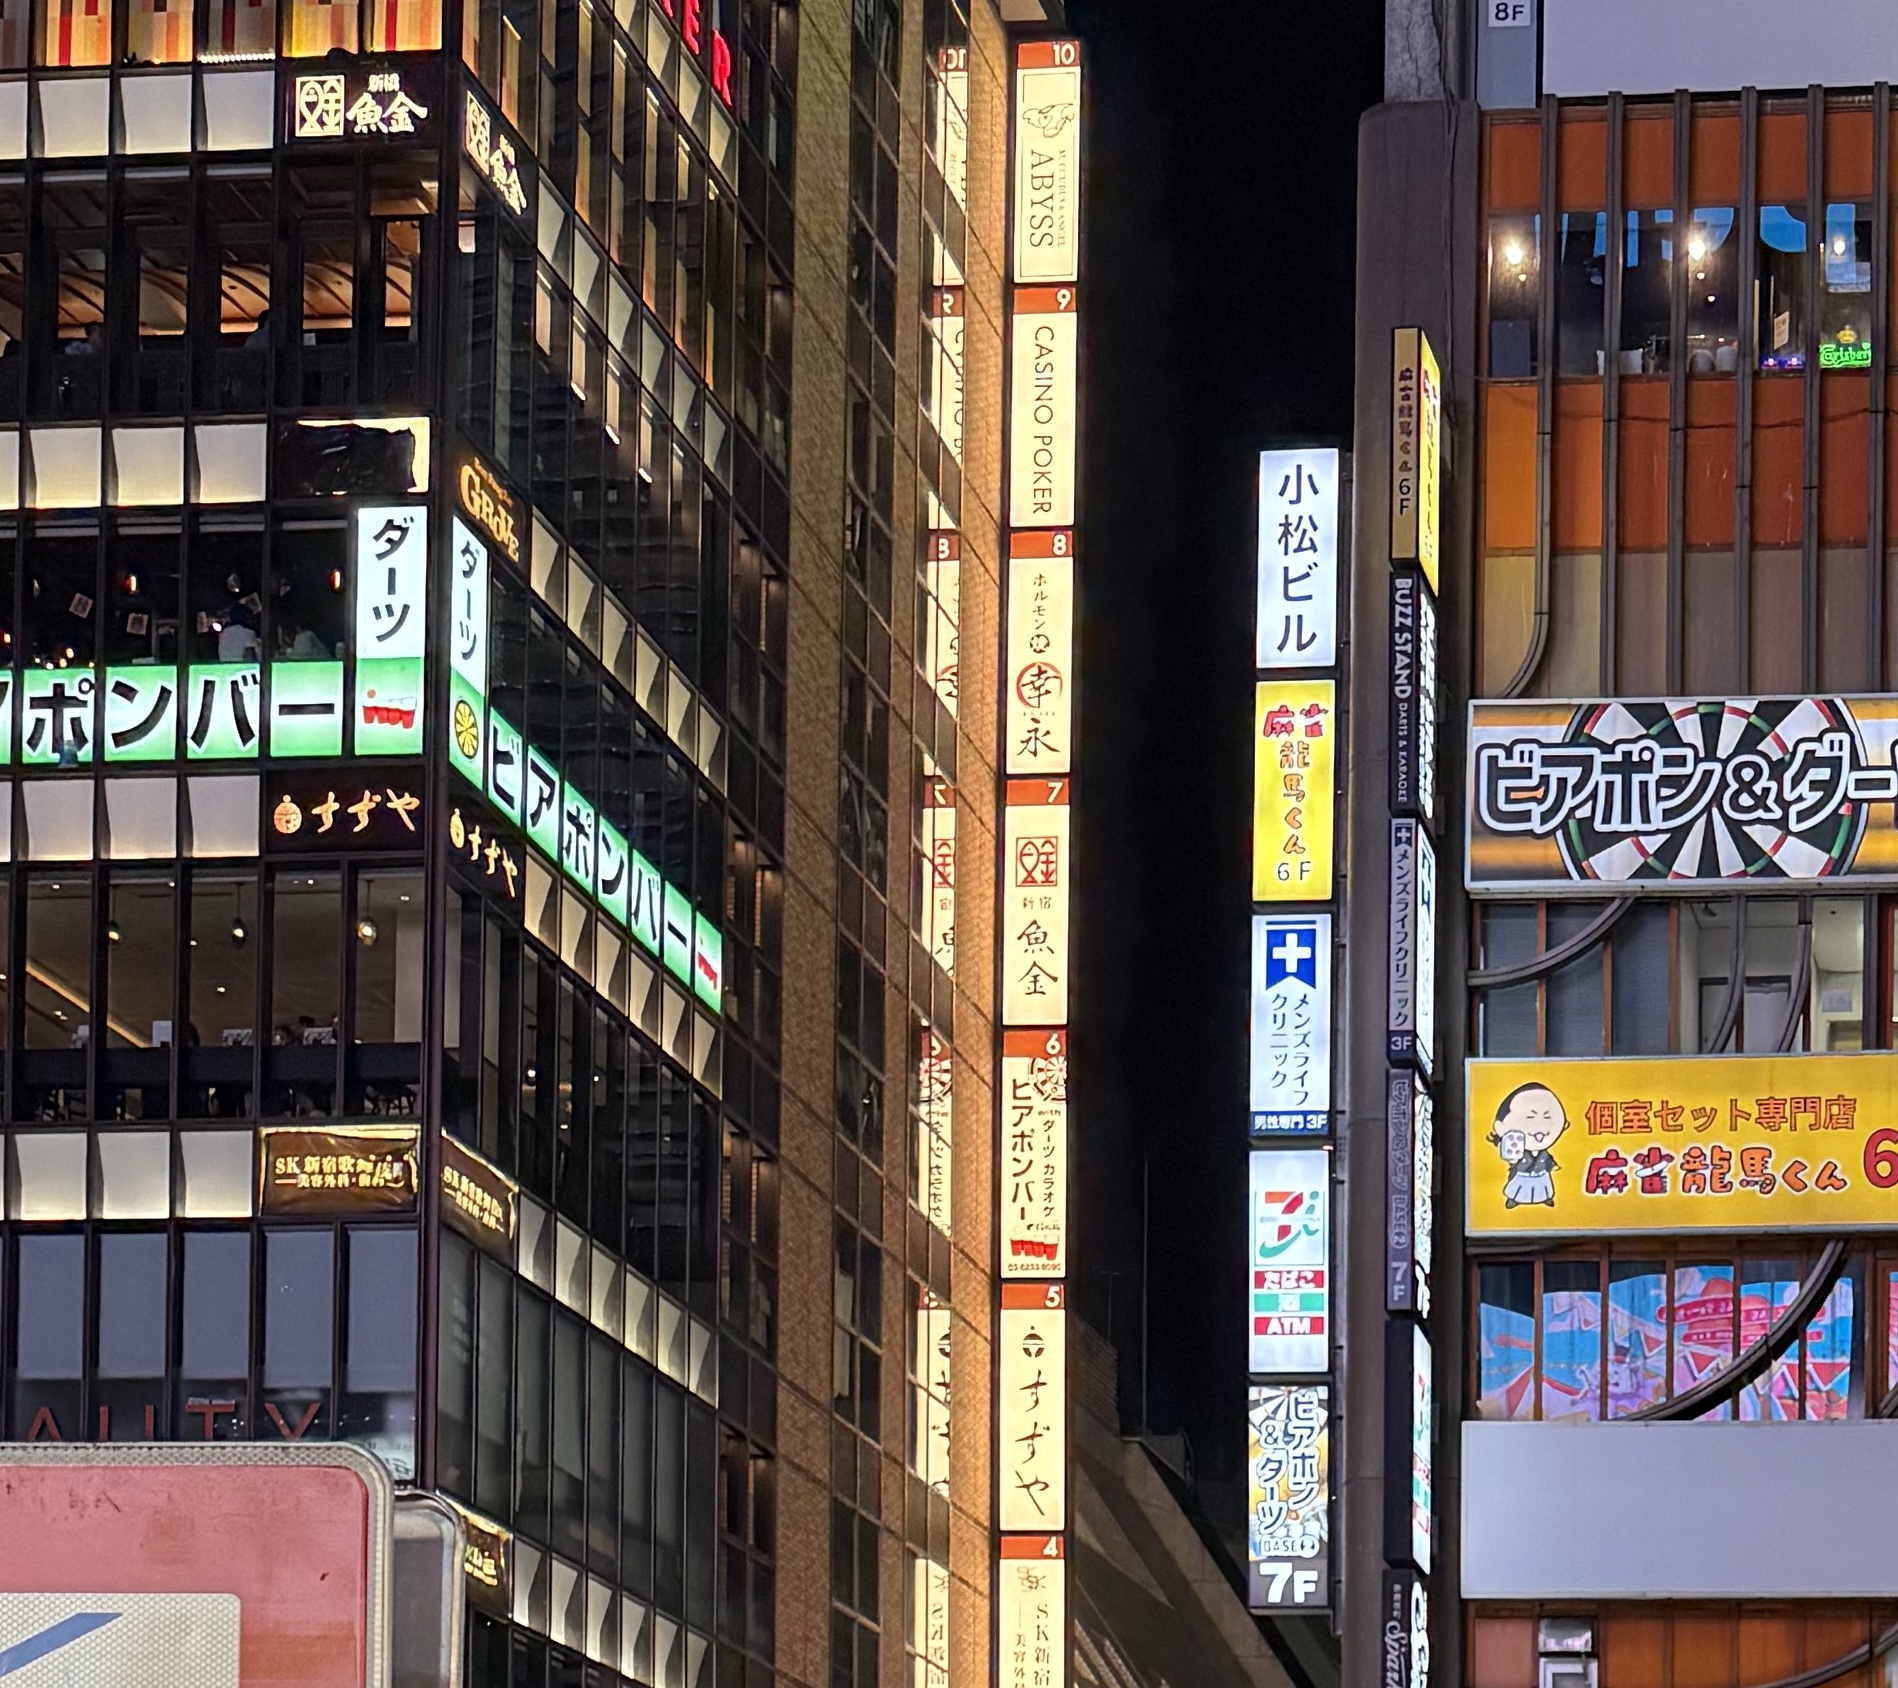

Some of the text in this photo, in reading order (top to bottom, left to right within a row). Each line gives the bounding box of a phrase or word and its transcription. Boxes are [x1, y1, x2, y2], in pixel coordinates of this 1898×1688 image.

[1495, 2, 1525, 27] 8F
[1052, 42, 1076, 66] 10
[346, 92, 428, 134] 魚金
[1029, 148, 1055, 248] ABYSS
[1055, 288, 1072, 311] 9
[1031, 324, 1054, 517] CASINO POKER
[1398, 478, 1415, 515] 6F
[1051, 534, 1067, 557] 8
[1278, 463, 1318, 654] 小松ビル
[371, 516, 414, 644] ダーツ
[458, 538, 481, 662] ダーツ
[1394, 577, 1413, 699] BUZZ STAND
[1017, 662, 1063, 758] 幸永
[312, 787, 421, 833] すずや
[1047, 781, 1062, 804] 7
[1279, 740, 1311, 857] 龍馬くん
[488, 723, 690, 948] ビアポンバー
[467, 821, 519, 900] すずや
[1276, 860, 1312, 883] 6F
[1016, 919, 1059, 998] 魚金
[1395, 849, 1413, 1027] メンズライフクリニック
[1045, 1033, 1061, 1056] 6
[1269, 993, 1287, 1089] クリニック
[1291, 993, 1310, 1107] メンズライフ
[1391, 1035, 1412, 1051] 3F
[1305, 1113, 1328, 1130] 3F
[1585, 1096, 1857, 1134] 個室セット専門店
[1011, 1078, 1036, 1221] ビアポンバー
[1042, 1119, 1055, 1159] ダーツ
[1585, 1146, 1851, 1197] 麻雀龍馬くん
[1045, 1286, 1060, 1308] 5
[1261, 1270, 1316, 1290] たばこ
[1393, 1260, 1411, 1301] 7F
[1265, 1317, 1313, 1335] ATM
[1014, 1370, 1051, 1516] すずや
[1286, 1392, 1319, 1509] ビアポン
[1043, 1536, 1058, 1557] 4
[1257, 1561, 1319, 1604] 7F
